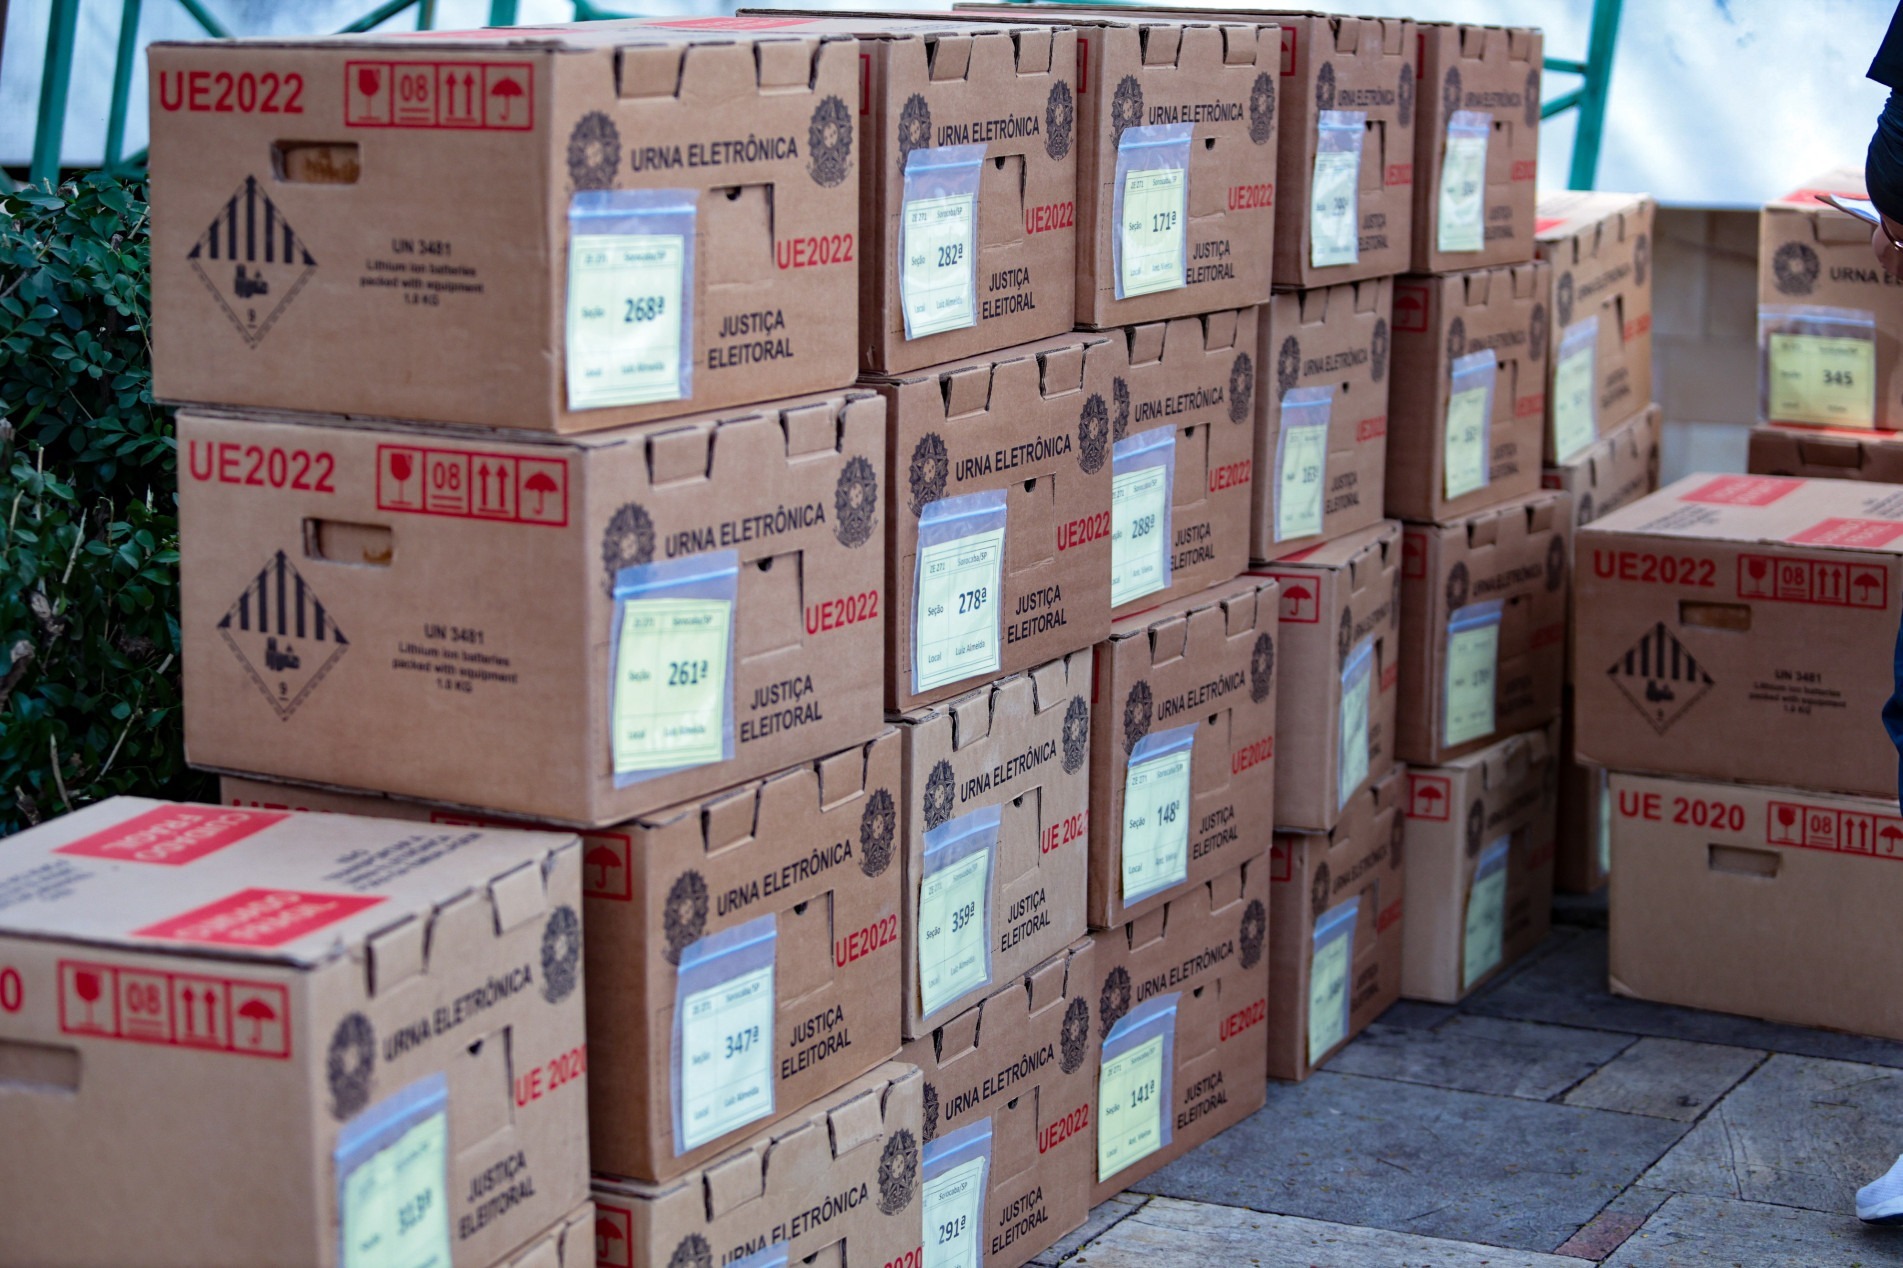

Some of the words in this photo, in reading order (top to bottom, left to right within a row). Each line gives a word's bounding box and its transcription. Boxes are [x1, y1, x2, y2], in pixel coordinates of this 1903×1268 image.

[160, 72, 304, 114] UE2022
[402, 74, 428, 102] 08
[1149, 104, 1180, 125] URNA
[1181, 100, 1244, 124] ELETRÔNICA
[938, 124, 970, 147] URNA
[972, 114, 1040, 143] ELETRÔNICA
[631, 146, 684, 172] URNA
[688, 134, 798, 168] ELETRÔNICA
[1228, 183, 1272, 212] UE2022
[1026, 201, 1074, 234] UE2022
[1128, 222, 1142, 232] Seção
[1152, 210, 1176, 232] 171ª
[392, 238, 414, 254] UN
[419, 240, 451, 256] 3481
[777, 233, 854, 270] UE2022
[910, 256, 926, 268] Seção
[938, 243, 964, 268] 282ª
[1193, 240, 1230, 262] JUSTIÇA
[988, 266, 1030, 292] JUSTIÇA
[1186, 262, 1236, 286] ELEITORAL
[1830, 266, 1879, 285] URNA
[982, 292, 1036, 320] ELEITORAL
[719, 309, 785, 338] JUSTIÇA
[708, 338, 794, 370] ELEITORAL
[1135, 401, 1164, 423] URNA
[1165, 386, 1224, 416] ELETRÔNICA
[190, 440, 336, 493] UE2022
[956, 456, 992, 482] URNA
[995, 434, 1072, 472] ELETRÔNICA
[434, 462, 461, 490] 08
[1209, 459, 1250, 493] UE2022
[664, 528, 717, 558] URNA
[720, 502, 826, 548] ELETRÔNICA
[1056, 510, 1111, 552] UE2022
[1132, 514, 1156, 539] 288ª
[1175, 522, 1212, 548] JUSTIÇA
[958, 552, 988, 566] Sorocaba/SP
[1594, 550, 1716, 588] UE2022
[1782, 565, 1805, 586] 08
[804, 589, 880, 636] UE2022
[928, 604, 944, 618] Seção
[958, 587, 986, 615] 278ª
[1016, 584, 1062, 616] JUSTIÇA
[424, 623, 447, 640] UN
[450, 626, 484, 644] 3481
[1007, 608, 1068, 644] ELEITORAL
[398, 641, 438, 658] Lithium
[928, 652, 942, 664] Local
[956, 645, 966, 656] Luiz
[966, 640, 986, 654] Almeida
[668, 660, 708, 686] 261ª
[751, 674, 814, 712] JUSTIÇA
[1157, 694, 1186, 722] URNA
[1187, 670, 1246, 710] ELETRÔNICA
[740, 700, 823, 744] ELEITORAL
[960, 771, 992, 804] URNA
[994, 738, 1058, 790] ELETRÔNICA
[1232, 735, 1274, 776] UE2022
[1128, 817, 1146, 830] Seção
[1200, 803, 1235, 836] JUSTIÇA
[1618, 790, 1663, 820] UE
[1673, 797, 1745, 832] 2020
[1810, 814, 1832, 834] 08
[1042, 824, 1060, 854] UE
[1062, 809, 1088, 844] 202
[1193, 825, 1238, 860] ELEITORAL
[717, 884, 759, 917] URNA
[763, 838, 853, 898] ELETRÔNICA
[1128, 864, 1142, 874] Local
[926, 926, 941, 940] Seção
[952, 900, 975, 933] 359ª
[1008, 888, 1046, 925] JUSTIÇA
[835, 913, 897, 968] UE2022
[1001, 912, 1050, 953] ELEITORAL
[1136, 973, 1168, 1002] URNA
[1170, 940, 1234, 986] ELETRÔNICA
[384, 1023, 431, 1063] URNA
[433, 964, 534, 1037] ELETRÔNICA
[790, 1004, 844, 1048] JUSTIÇA
[1220, 998, 1266, 1043] UE2022
[724, 1025, 759, 1059] 347ª
[780, 1028, 852, 1080] ELEITORAL
[516, 1077, 544, 1108] UE
[945, 1086, 980, 1122] URNA
[982, 1044, 1055, 1102] ELETRÔNICA
[1131, 1080, 1155, 1108] 141ª
[1184, 1070, 1224, 1104] JUSTIÇA
[1177, 1090, 1228, 1131] ELEITORAL
[1038, 1102, 1090, 1155] UE2022
[466, 1150, 528, 1203] JUSTIÇA
[938, 1181, 968, 1201] Sorocaba/SP
[458, 1176, 536, 1240] ELEITORAL
[999, 1186, 1044, 1227] JUSTIÇA
[938, 1214, 966, 1245] 291ª
[992, 1206, 1048, 1256] ELEITORAL
